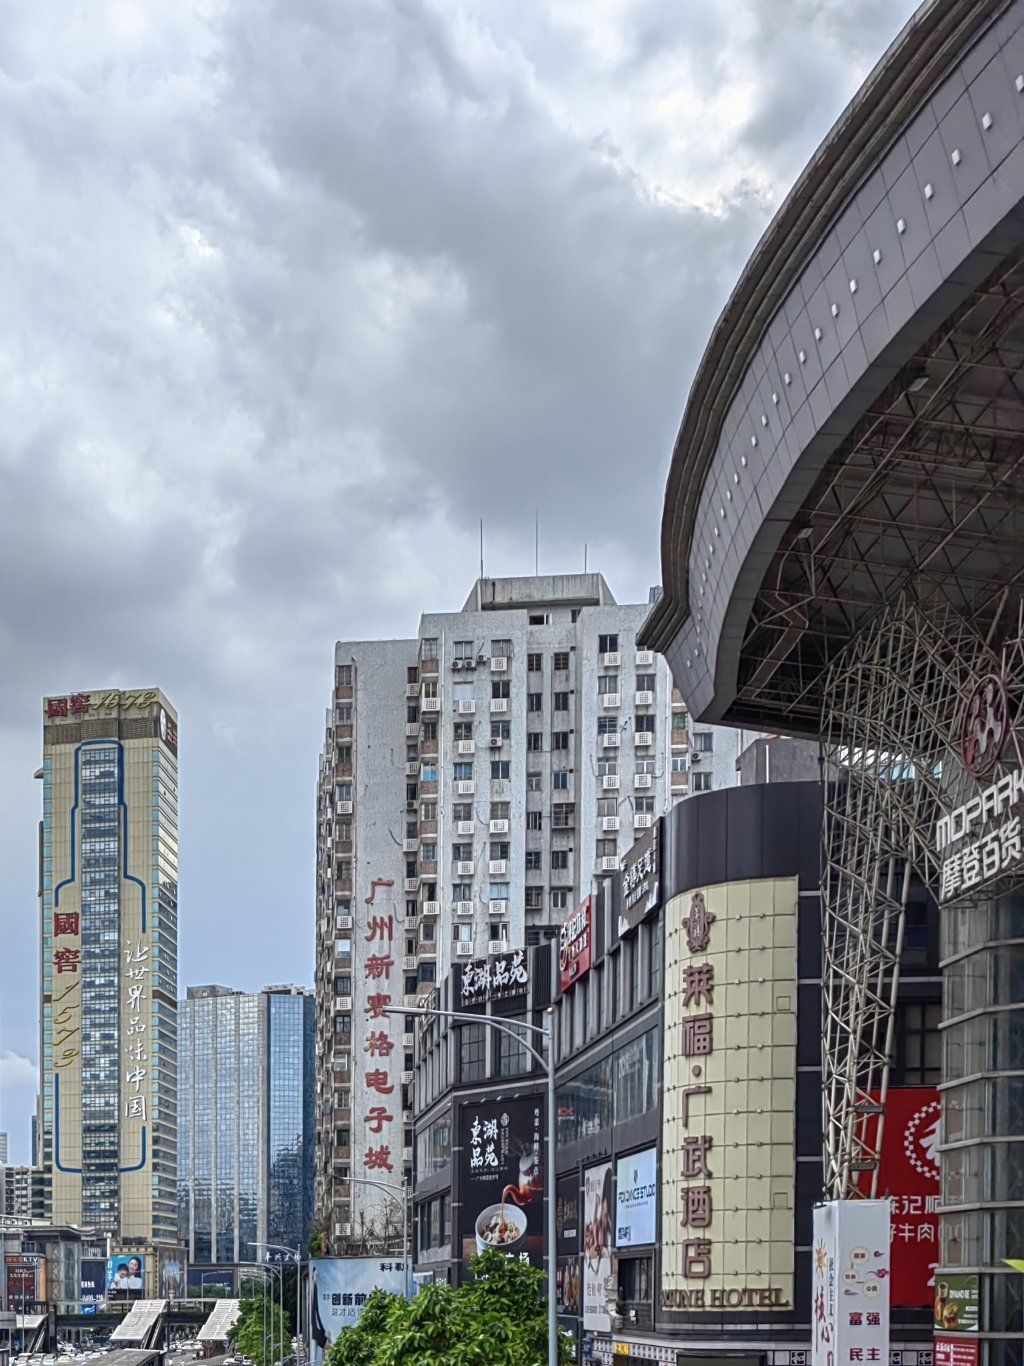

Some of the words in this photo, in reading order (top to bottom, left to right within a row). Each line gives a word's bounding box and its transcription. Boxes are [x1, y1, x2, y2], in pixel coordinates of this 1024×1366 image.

[942, 816, 1022, 899] 摩登百货
[124, 939, 149, 1123] 让世界品味中国
[363, 878, 394, 1174] 广州新赛格电子城
[710, 1288, 790, 1307] HOTEL
[848, 1311, 880, 1326] 富强
[848, 1347, 880, 1362] 民主
